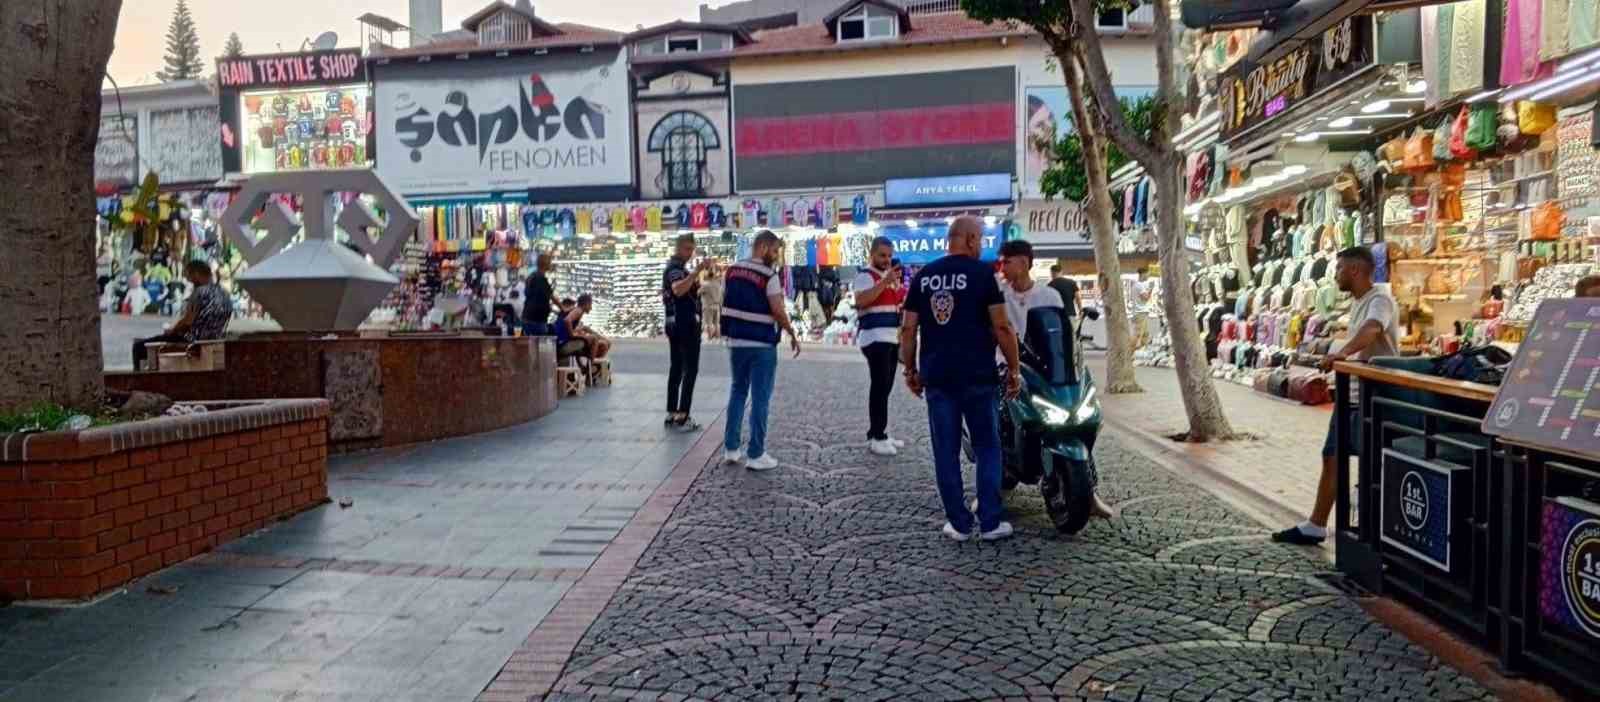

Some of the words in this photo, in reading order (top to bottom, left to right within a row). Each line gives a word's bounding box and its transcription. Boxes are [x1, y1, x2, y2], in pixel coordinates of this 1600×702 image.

[219, 61, 255, 85] RAIN
[257, 56, 317, 83] TEXTILE
[319, 53, 358, 79] SHOP
[736, 118, 858, 155] ARENA
[880, 106, 1010, 144] STORE
[489, 145, 606, 172] FENOMEN
[916, 184, 944, 194] ARYA
[946, 183, 978, 194] TEKEL
[891, 239, 929, 252] ARYA
[920, 274, 967, 293] POLIS
[1406, 502, 1422, 520] BAR
